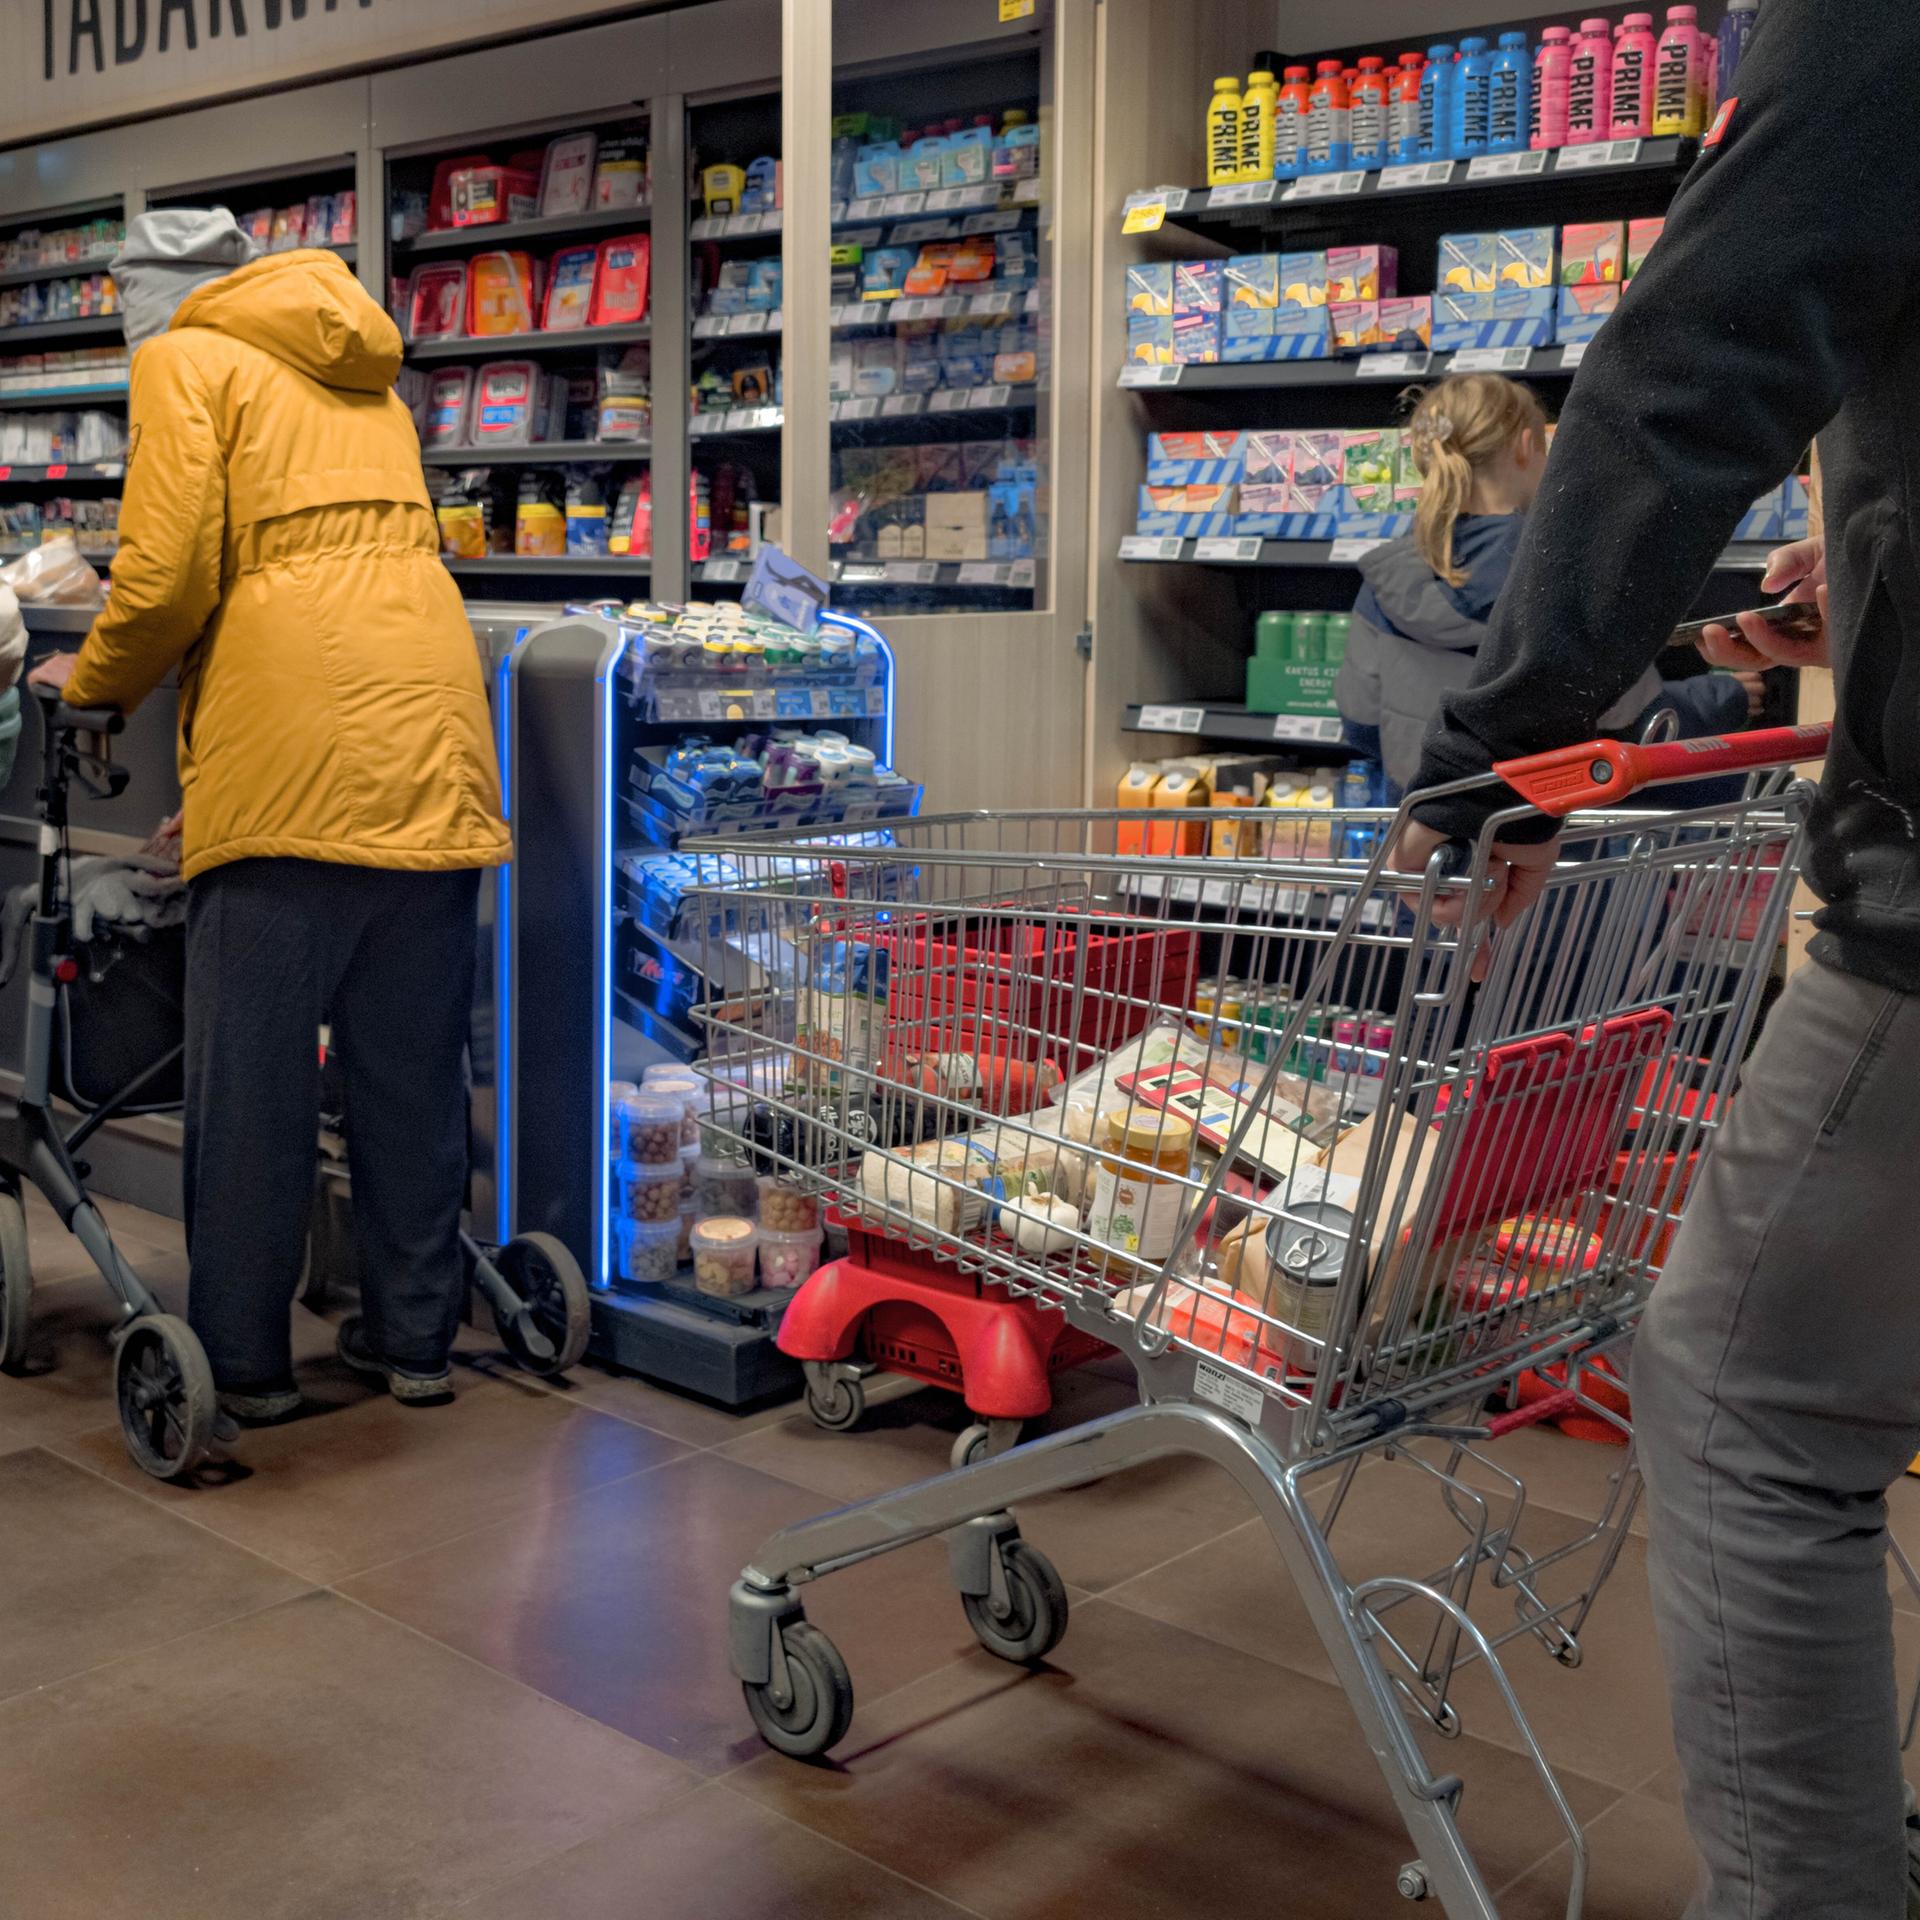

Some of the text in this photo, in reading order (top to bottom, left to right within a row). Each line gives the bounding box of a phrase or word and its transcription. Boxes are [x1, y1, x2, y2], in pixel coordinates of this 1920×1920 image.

[1418, 83, 1434, 152] PRIME
[1491, 70, 1518, 142] PRIME
[1569, 56, 1594, 129] PRIME
[1612, 51, 1642, 127] PRIME
[1657, 45, 1687, 121] PRIME
[1213, 110, 1238, 174] PRIME
[1241, 105, 1260, 168] PRIME
[1299, 678, 1331, 688] ENERGY
[1199, 1362, 1226, 1381] wanzl
